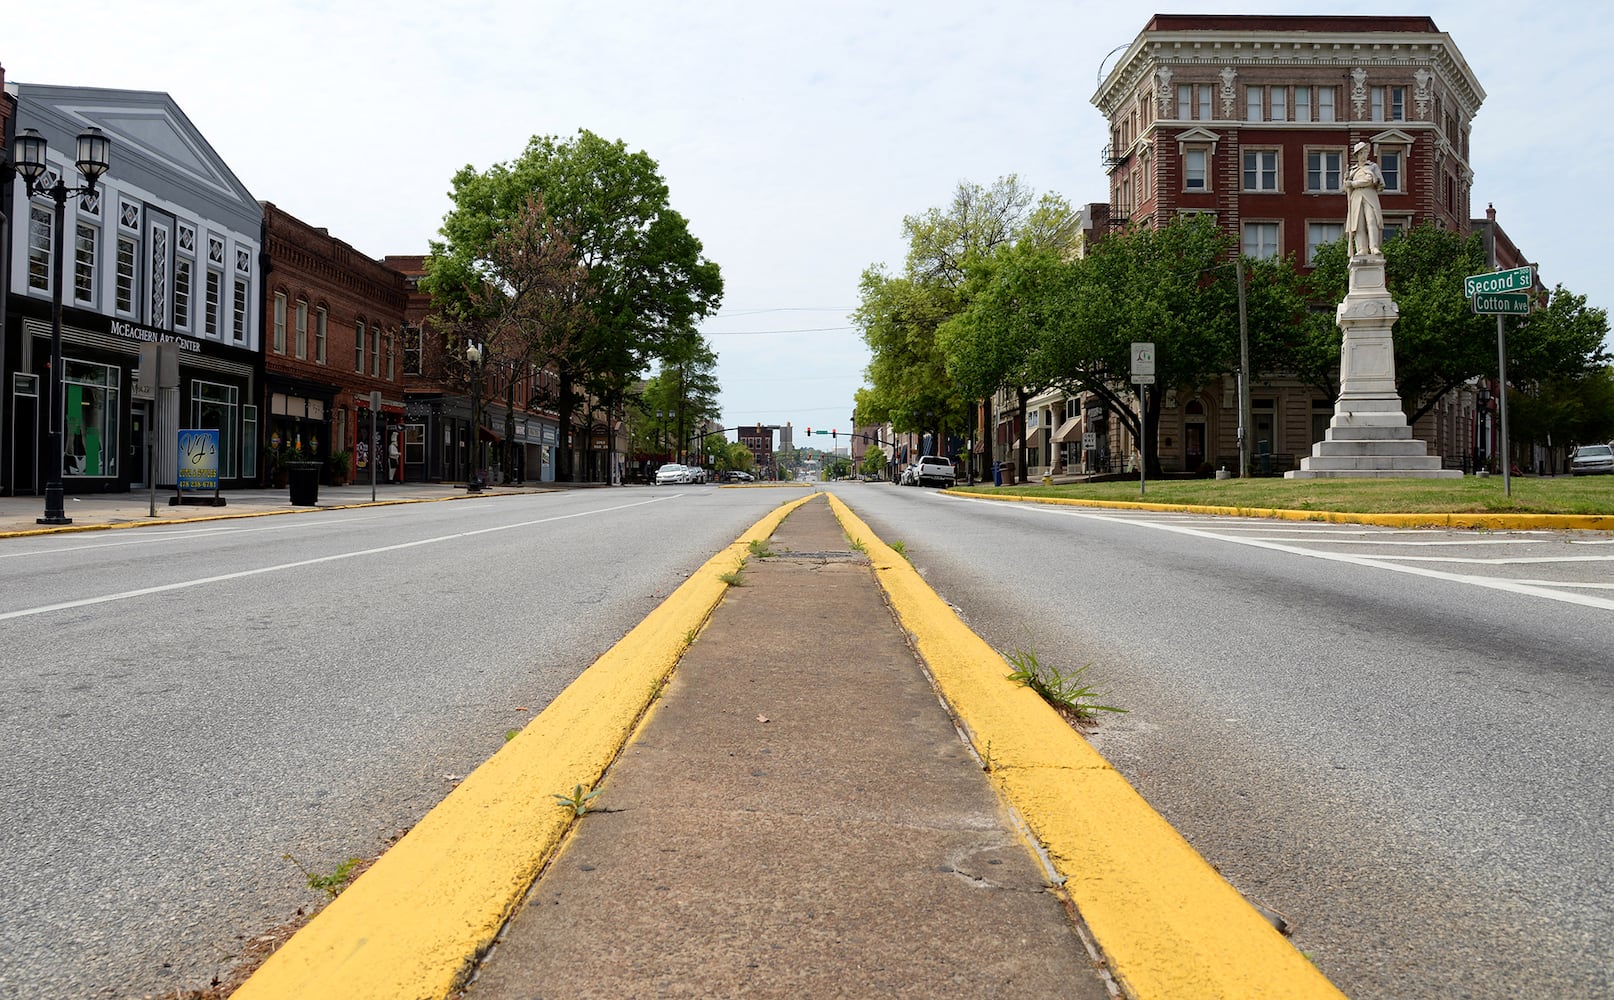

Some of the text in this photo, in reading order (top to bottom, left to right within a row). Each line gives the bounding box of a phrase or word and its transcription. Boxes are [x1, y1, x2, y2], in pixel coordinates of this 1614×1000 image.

[1468, 274, 1529, 295] Second St
[1477, 296, 1528, 311] Cotton Ave
[175, 336, 201, 353] CENTER
